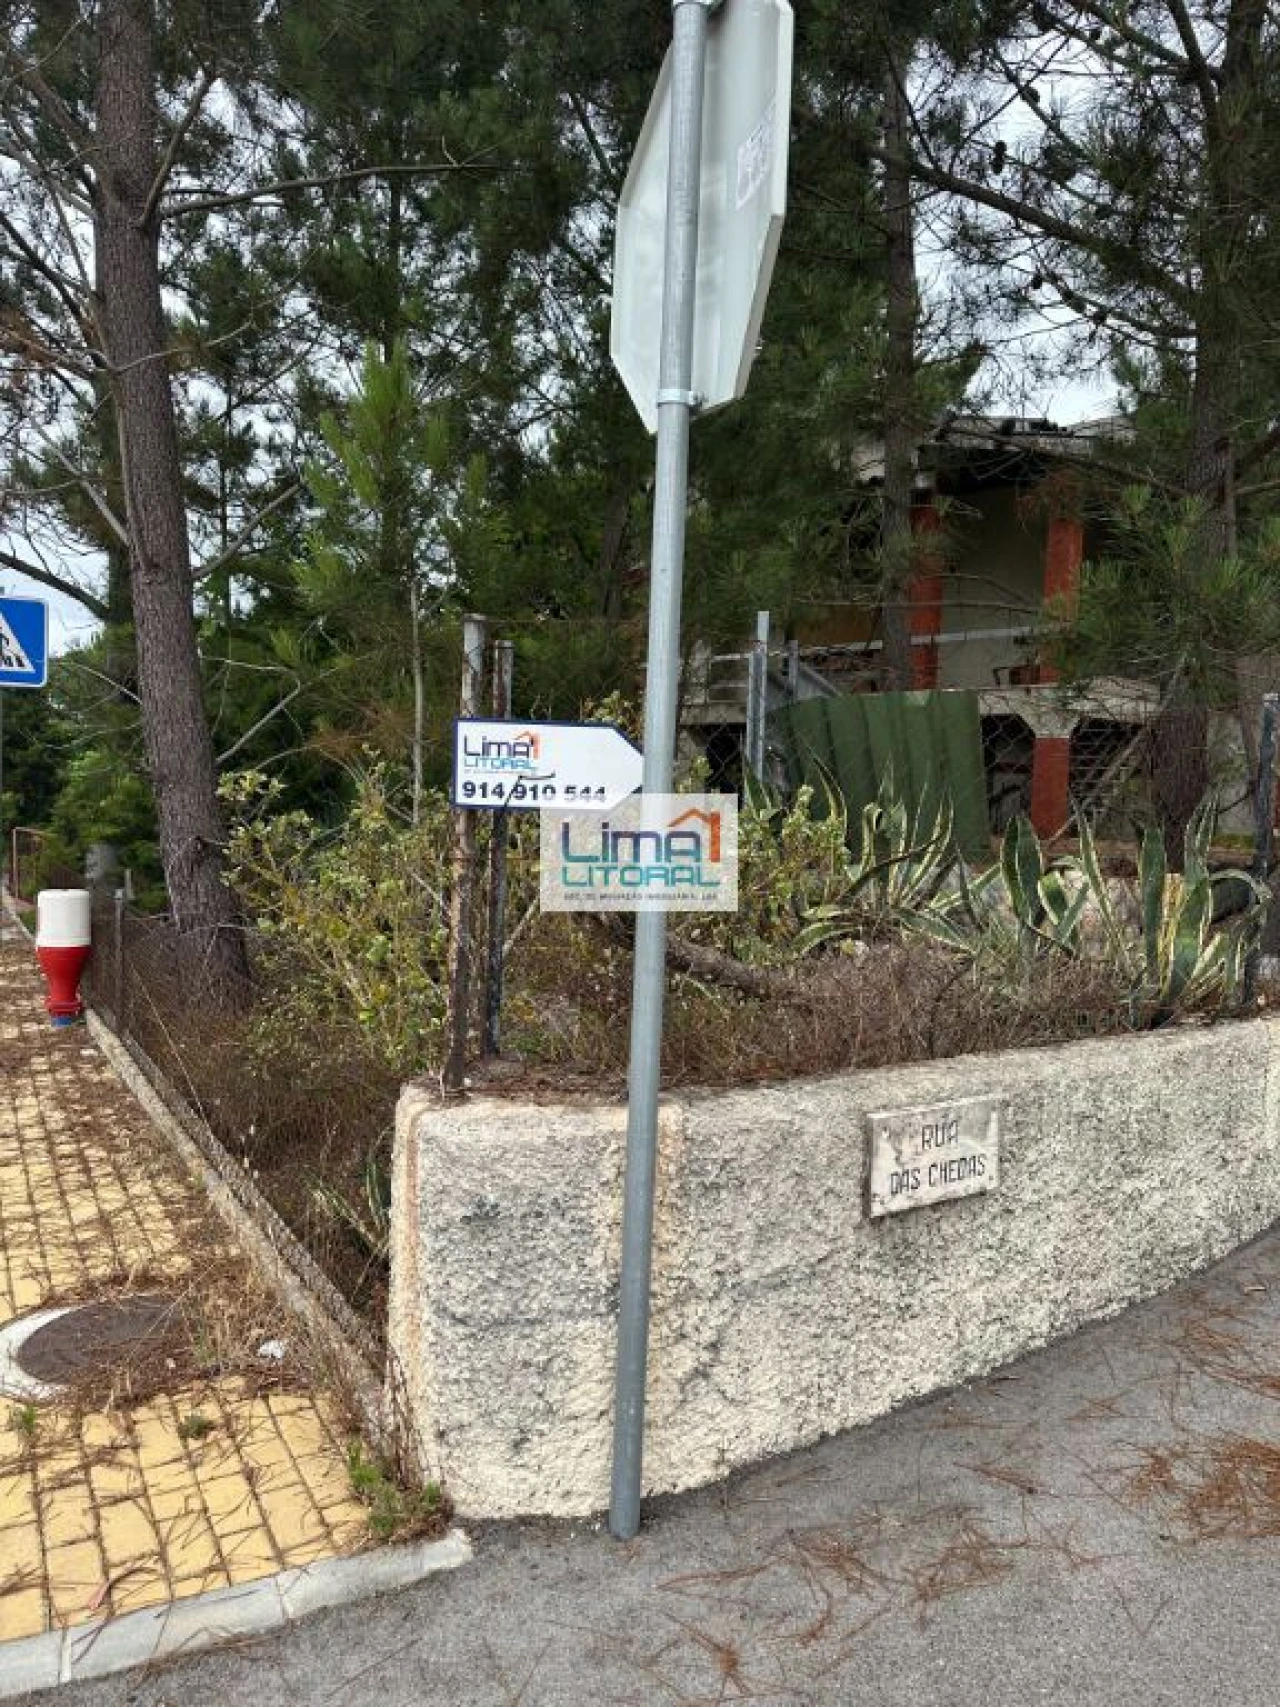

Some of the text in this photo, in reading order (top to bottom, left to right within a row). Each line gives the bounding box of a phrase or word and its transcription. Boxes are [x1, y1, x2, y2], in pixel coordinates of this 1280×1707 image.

[464, 758, 538, 770] LITORAL
[462, 780, 606, 803] 914 910 544
[921, 1120, 959, 1150] RUA
[890, 1168, 920, 1196] DAS
